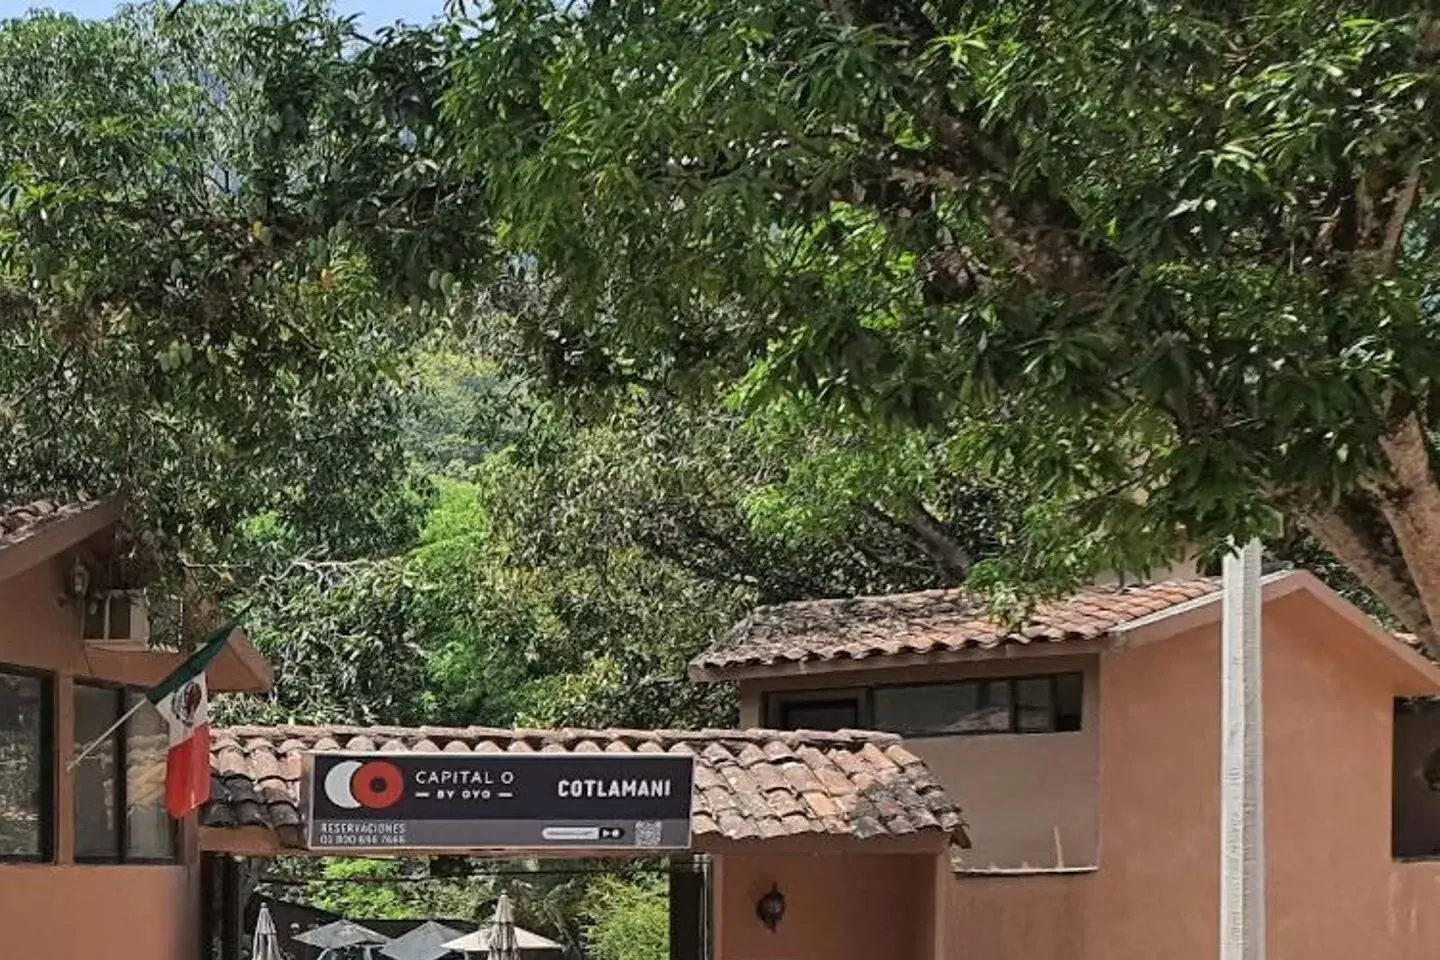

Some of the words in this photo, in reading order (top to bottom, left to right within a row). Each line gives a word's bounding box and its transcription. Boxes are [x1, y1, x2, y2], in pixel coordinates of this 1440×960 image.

[415, 770, 495, 785] CAPITAL
[500, 770, 515, 785] O
[436, 789, 455, 799] BY
[461, 789, 491, 799] OYO
[557, 778, 672, 798] COTLAMANI
[319, 822, 406, 834] RESERVACIONES
